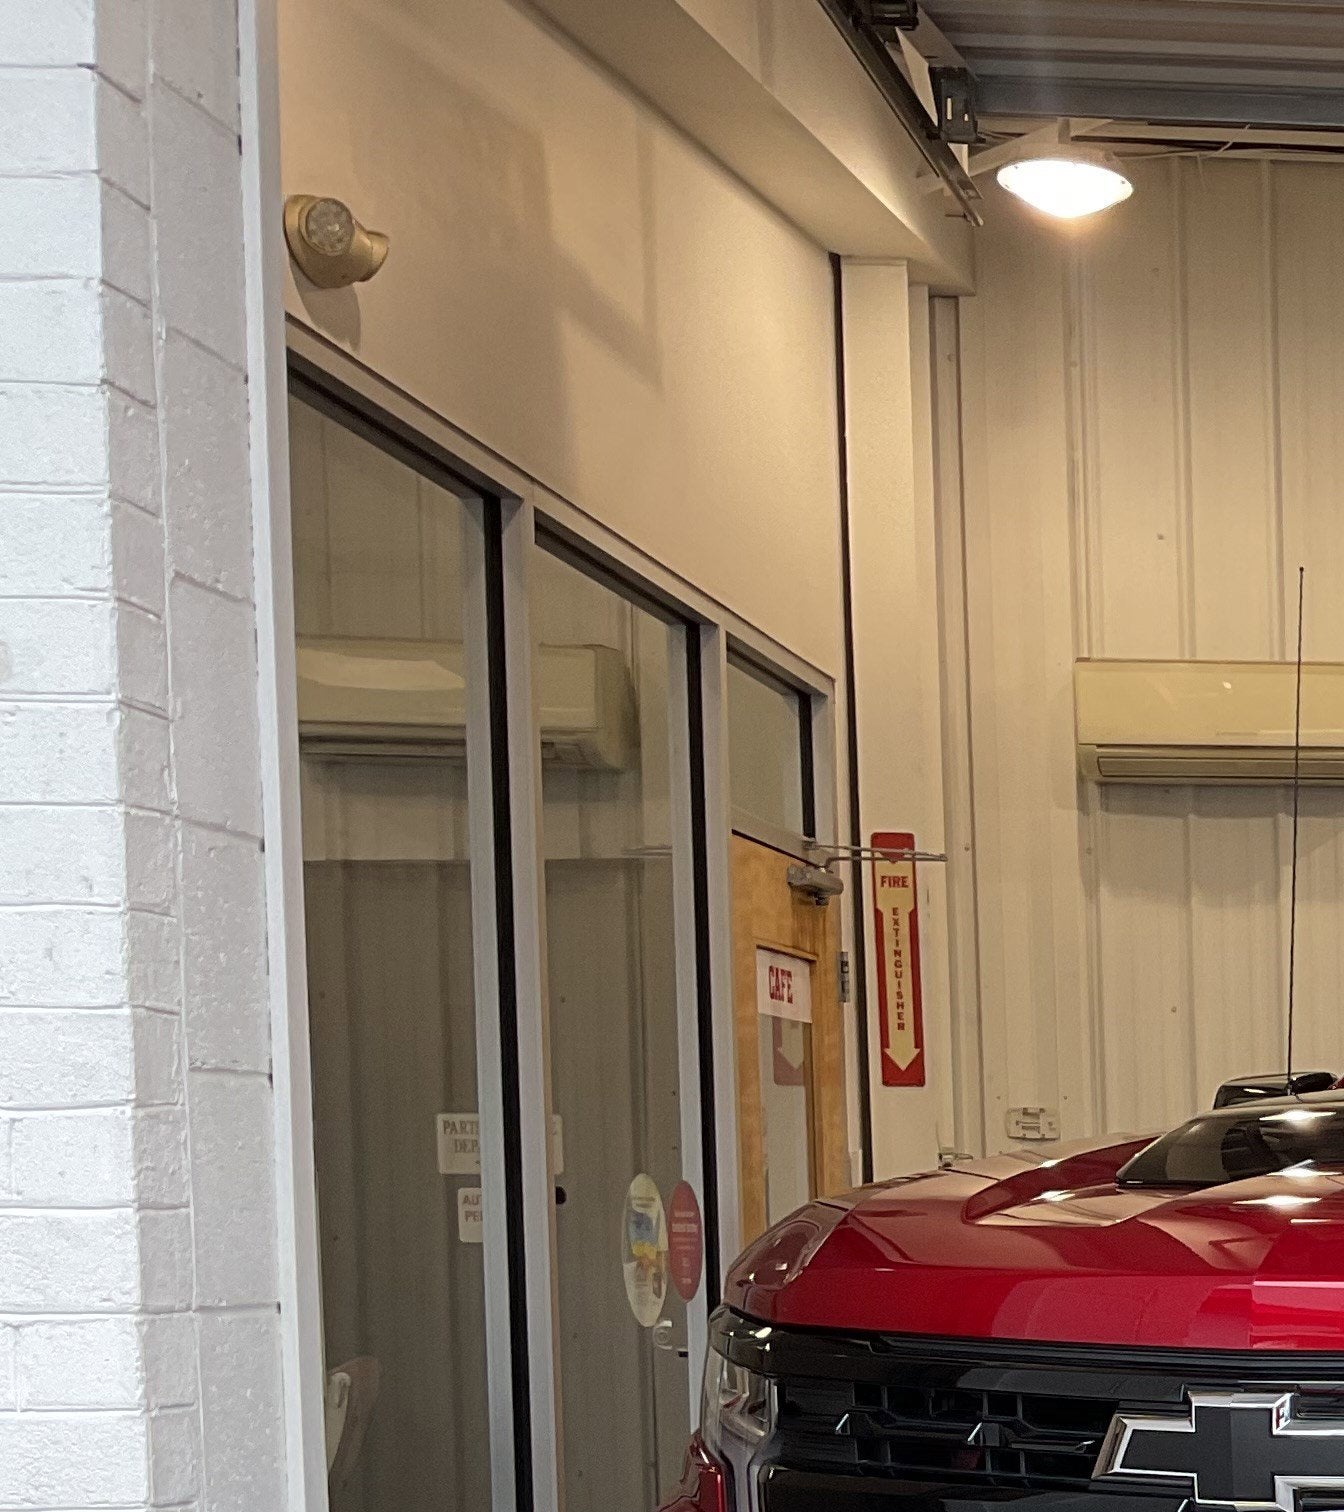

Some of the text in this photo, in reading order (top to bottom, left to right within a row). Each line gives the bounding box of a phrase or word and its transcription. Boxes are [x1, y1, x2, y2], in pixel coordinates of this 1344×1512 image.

[881, 875, 909, 889] FIRE
[768, 965, 794, 1004] CAFE
[891, 906, 906, 1031] EXTINGUISHER
